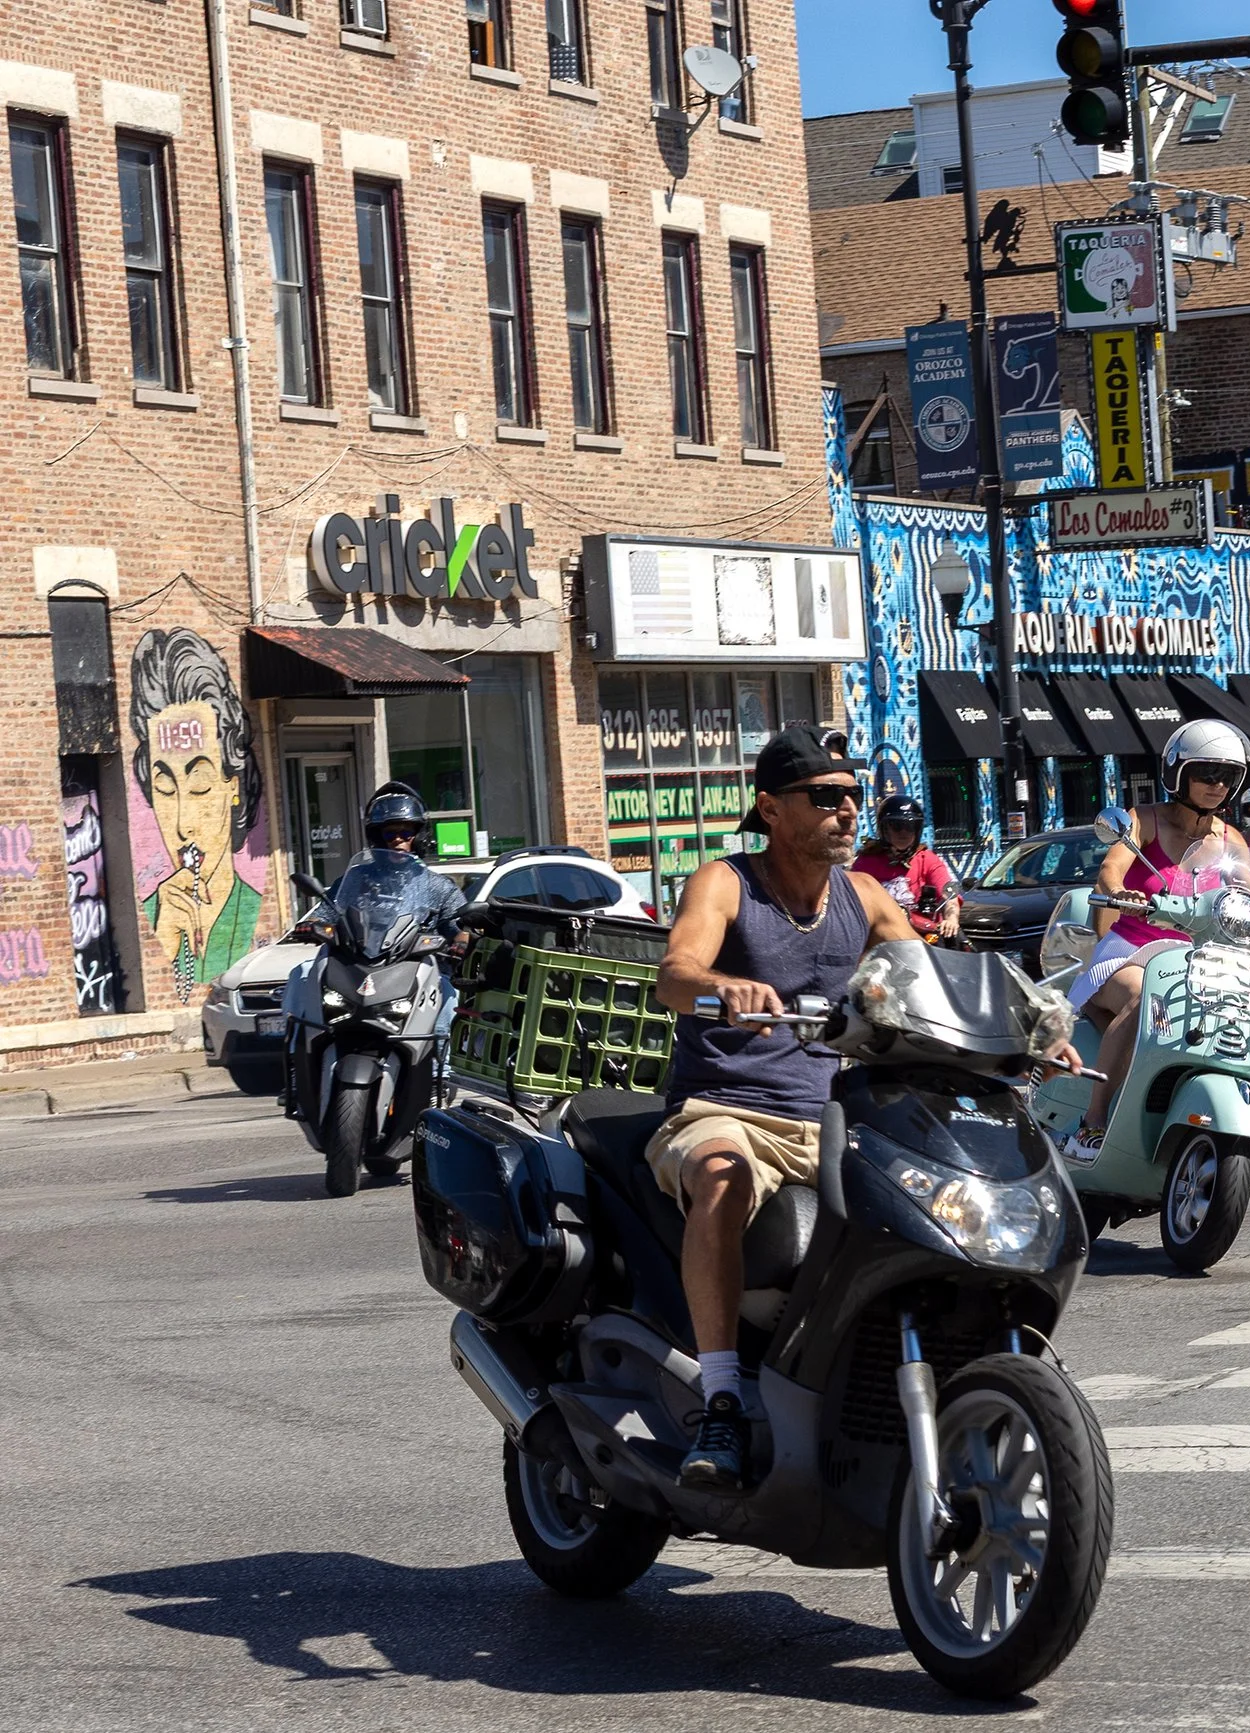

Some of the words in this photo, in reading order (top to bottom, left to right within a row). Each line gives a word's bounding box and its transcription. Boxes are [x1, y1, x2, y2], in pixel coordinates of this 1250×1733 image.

[1068, 233, 1147, 251] TAQUERIA
[913, 368, 967, 383] ACADEMY
[915, 357, 963, 372] OROZCO
[1104, 337, 1135, 483] TAQUERIA
[1005, 433, 1060, 448] PANTHERS
[1057, 501, 1091, 536] Los
[1095, 497, 1170, 537] Comales
[1169, 498, 1194, 530] #3
[312, 493, 539, 601] cricket
[1013, 611, 1098, 657] AQUERIA
[1102, 615, 1137, 656] LOS
[1142, 615, 1221, 657] COMALES
[955, 708, 989, 724] Fajitas
[157, 719, 204, 751] 11:59
[608, 788, 676, 822] ATTORNEY
[679, 786, 694, 817] AT
[423, 1128, 451, 1150] PIAGGIO
